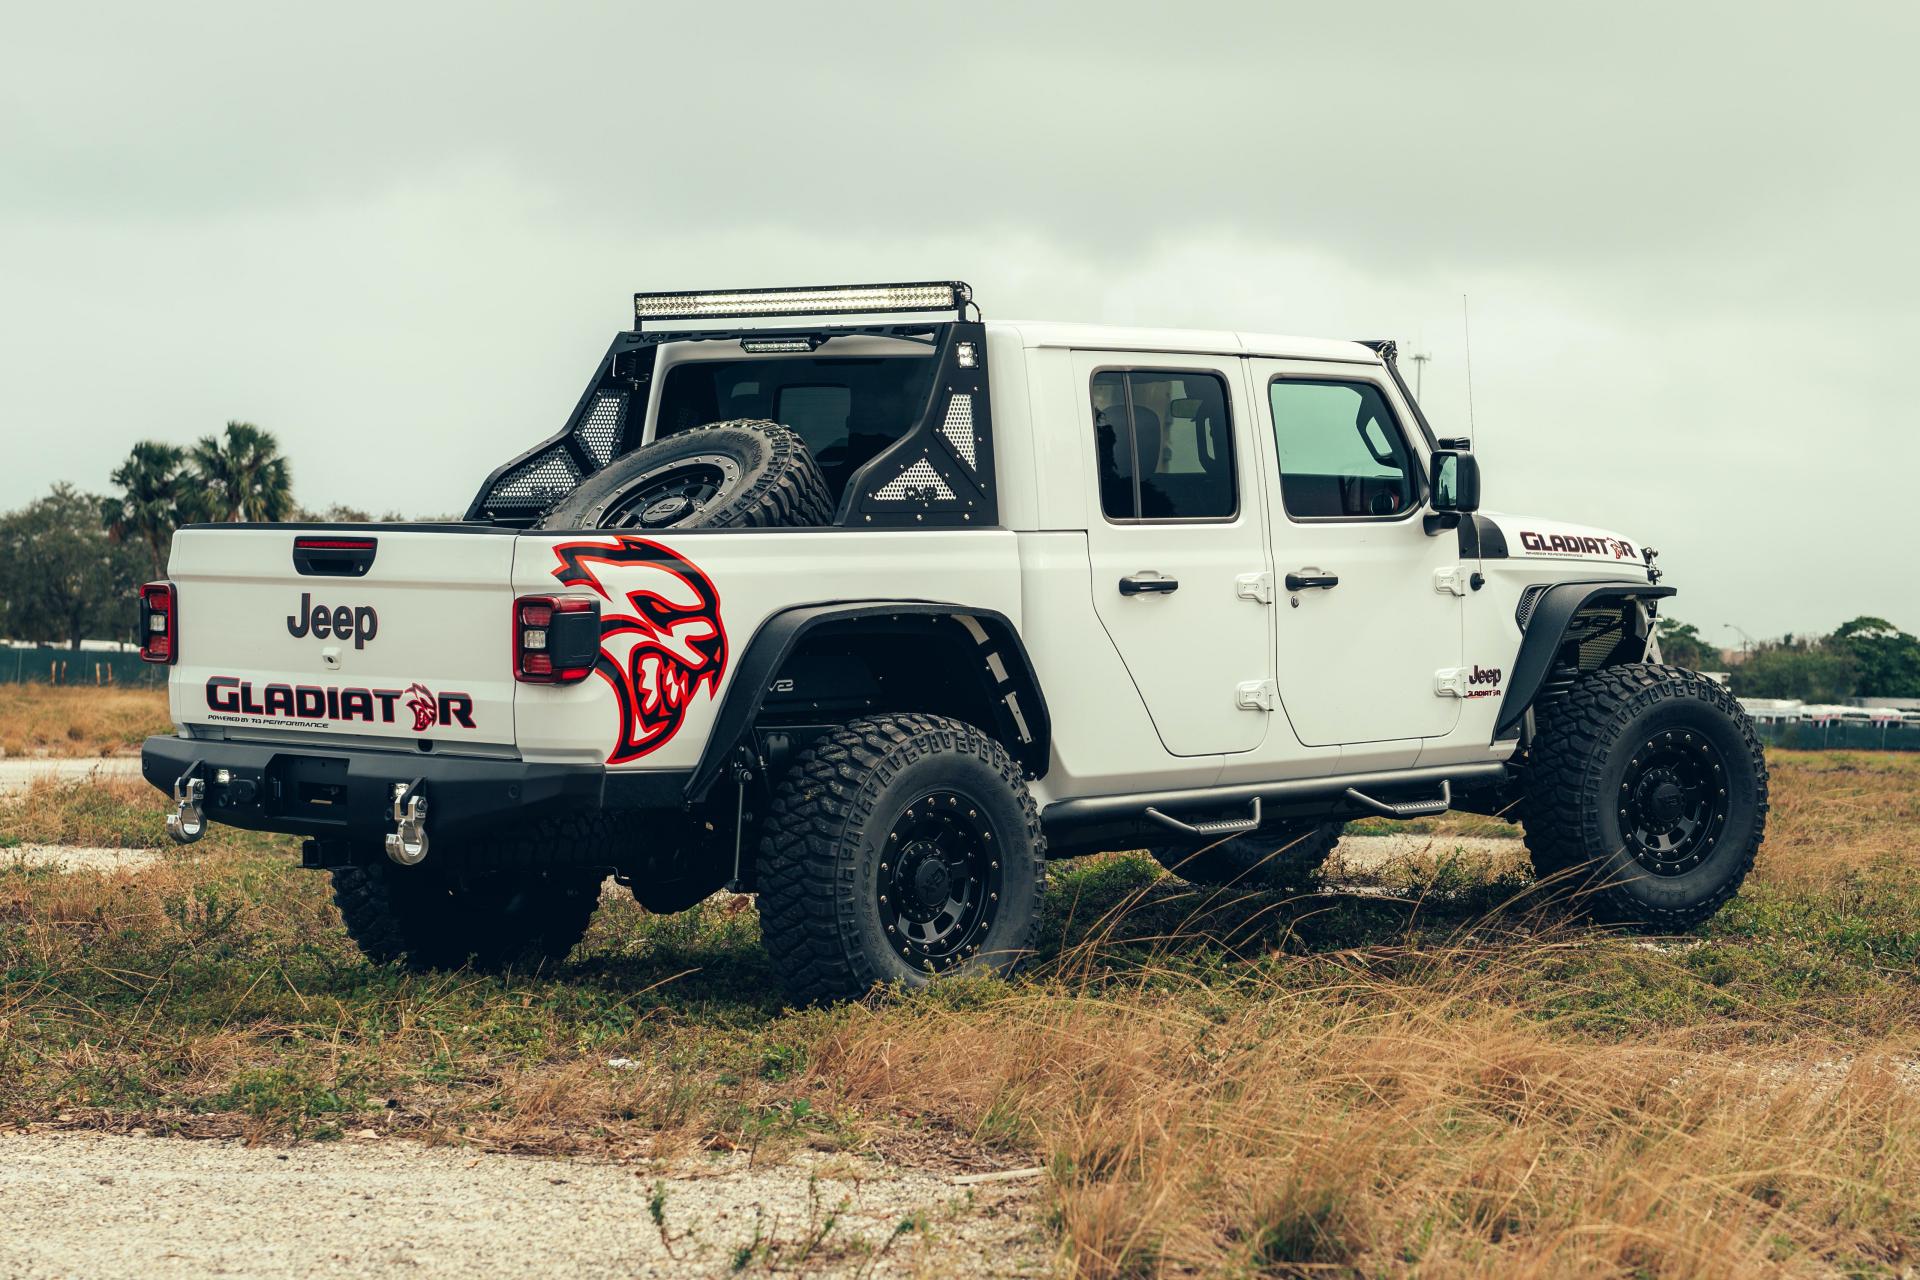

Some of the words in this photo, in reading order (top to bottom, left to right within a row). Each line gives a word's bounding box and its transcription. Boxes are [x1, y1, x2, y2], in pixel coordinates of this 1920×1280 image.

[287, 592, 378, 650] Jeep
[1469, 665, 1502, 687] Jeep
[208, 715, 240, 723] POWERED
[262, 719, 329, 729] PERFORMANCE
